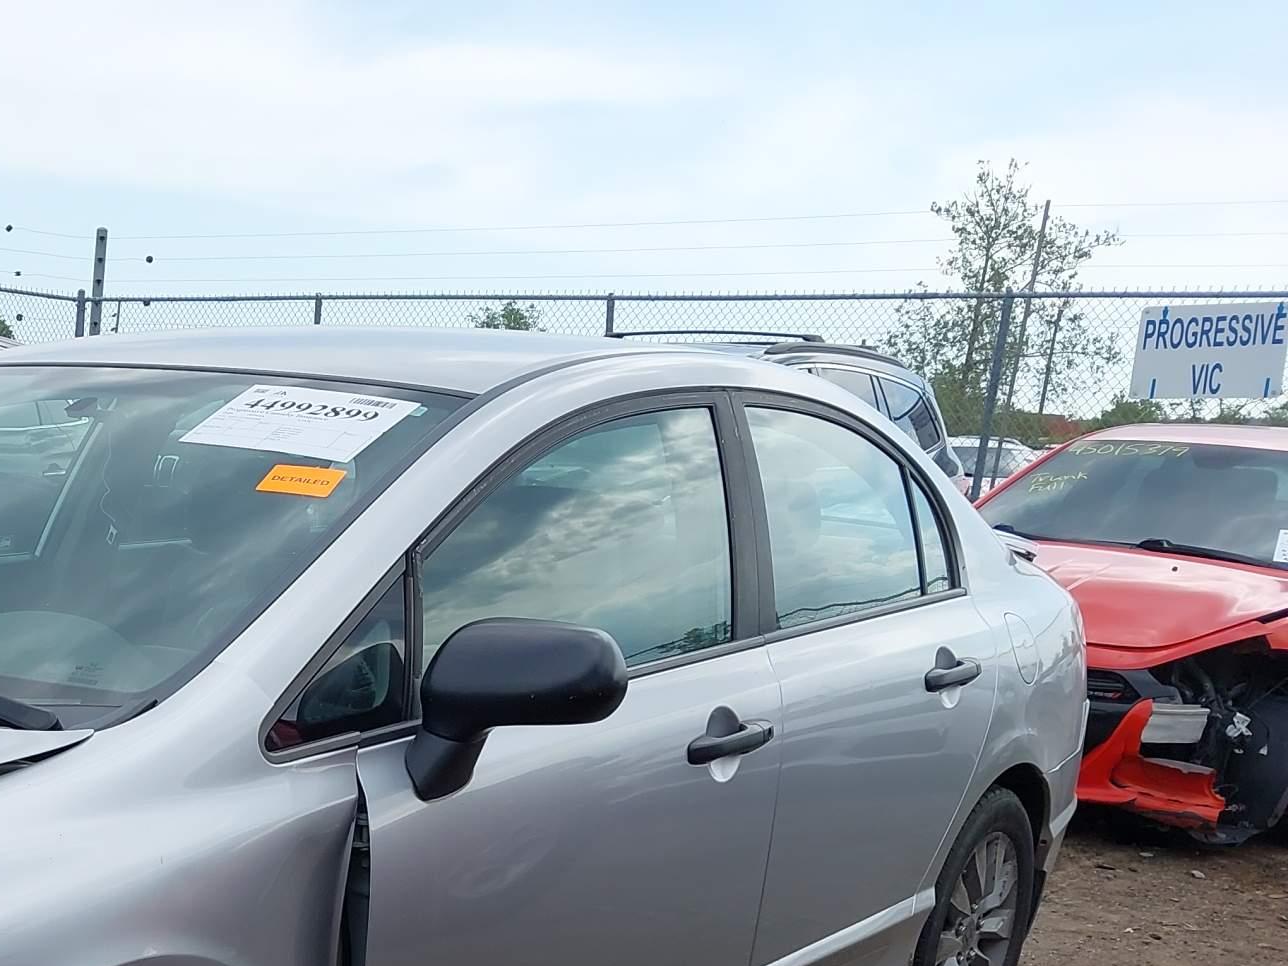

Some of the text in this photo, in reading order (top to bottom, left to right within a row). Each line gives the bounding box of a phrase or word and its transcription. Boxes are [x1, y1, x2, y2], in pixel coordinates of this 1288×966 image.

[1142, 312, 1287, 350] PROGRESSIVE
[1191, 362, 1223, 395] VIC
[244, 398, 380, 422] 44992899
[271, 475, 330, 486] DETAILED
